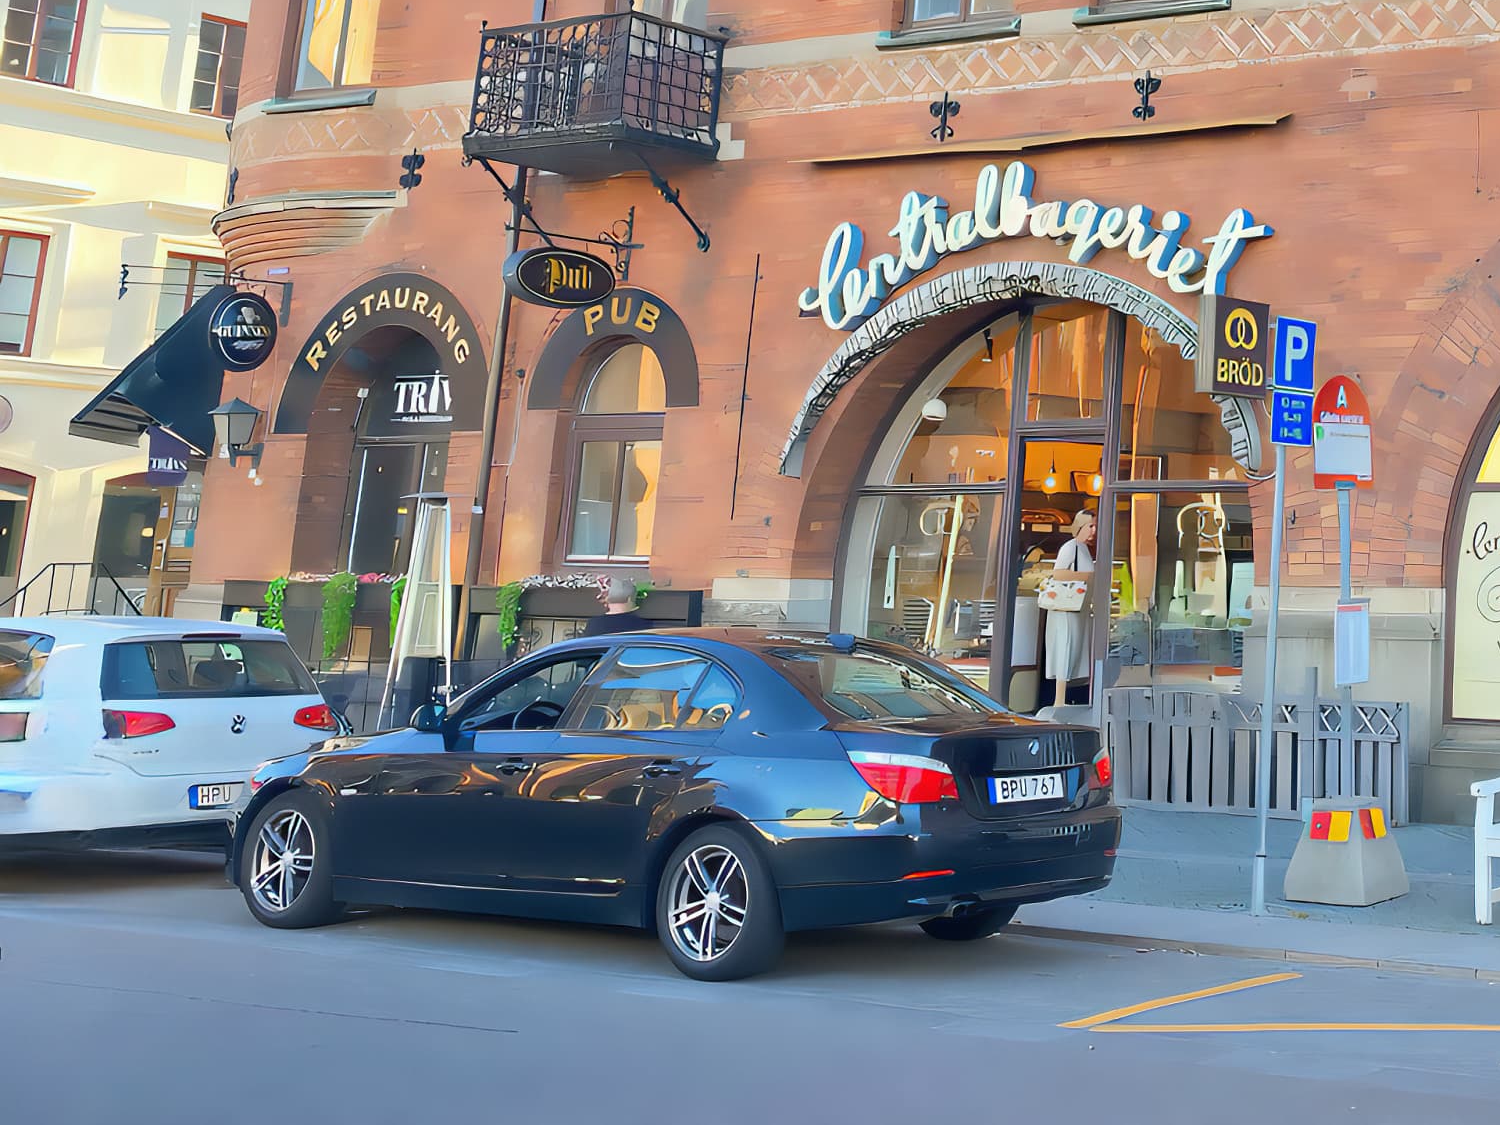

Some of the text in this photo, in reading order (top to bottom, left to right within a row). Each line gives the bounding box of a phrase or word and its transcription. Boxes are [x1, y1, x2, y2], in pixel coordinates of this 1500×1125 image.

[798, 160, 1274, 331] Centralbageriet
[305, 286, 471, 372] RESTAURANG
[583, 296, 661, 336] PUB
[1284, 324, 1309, 382] P
[1216, 356, 1264, 387] BRÖD
[1336, 385, 1348, 409] A
[200, 786, 232, 804] HPU
[1000, 776, 1056, 800] BPU 767
